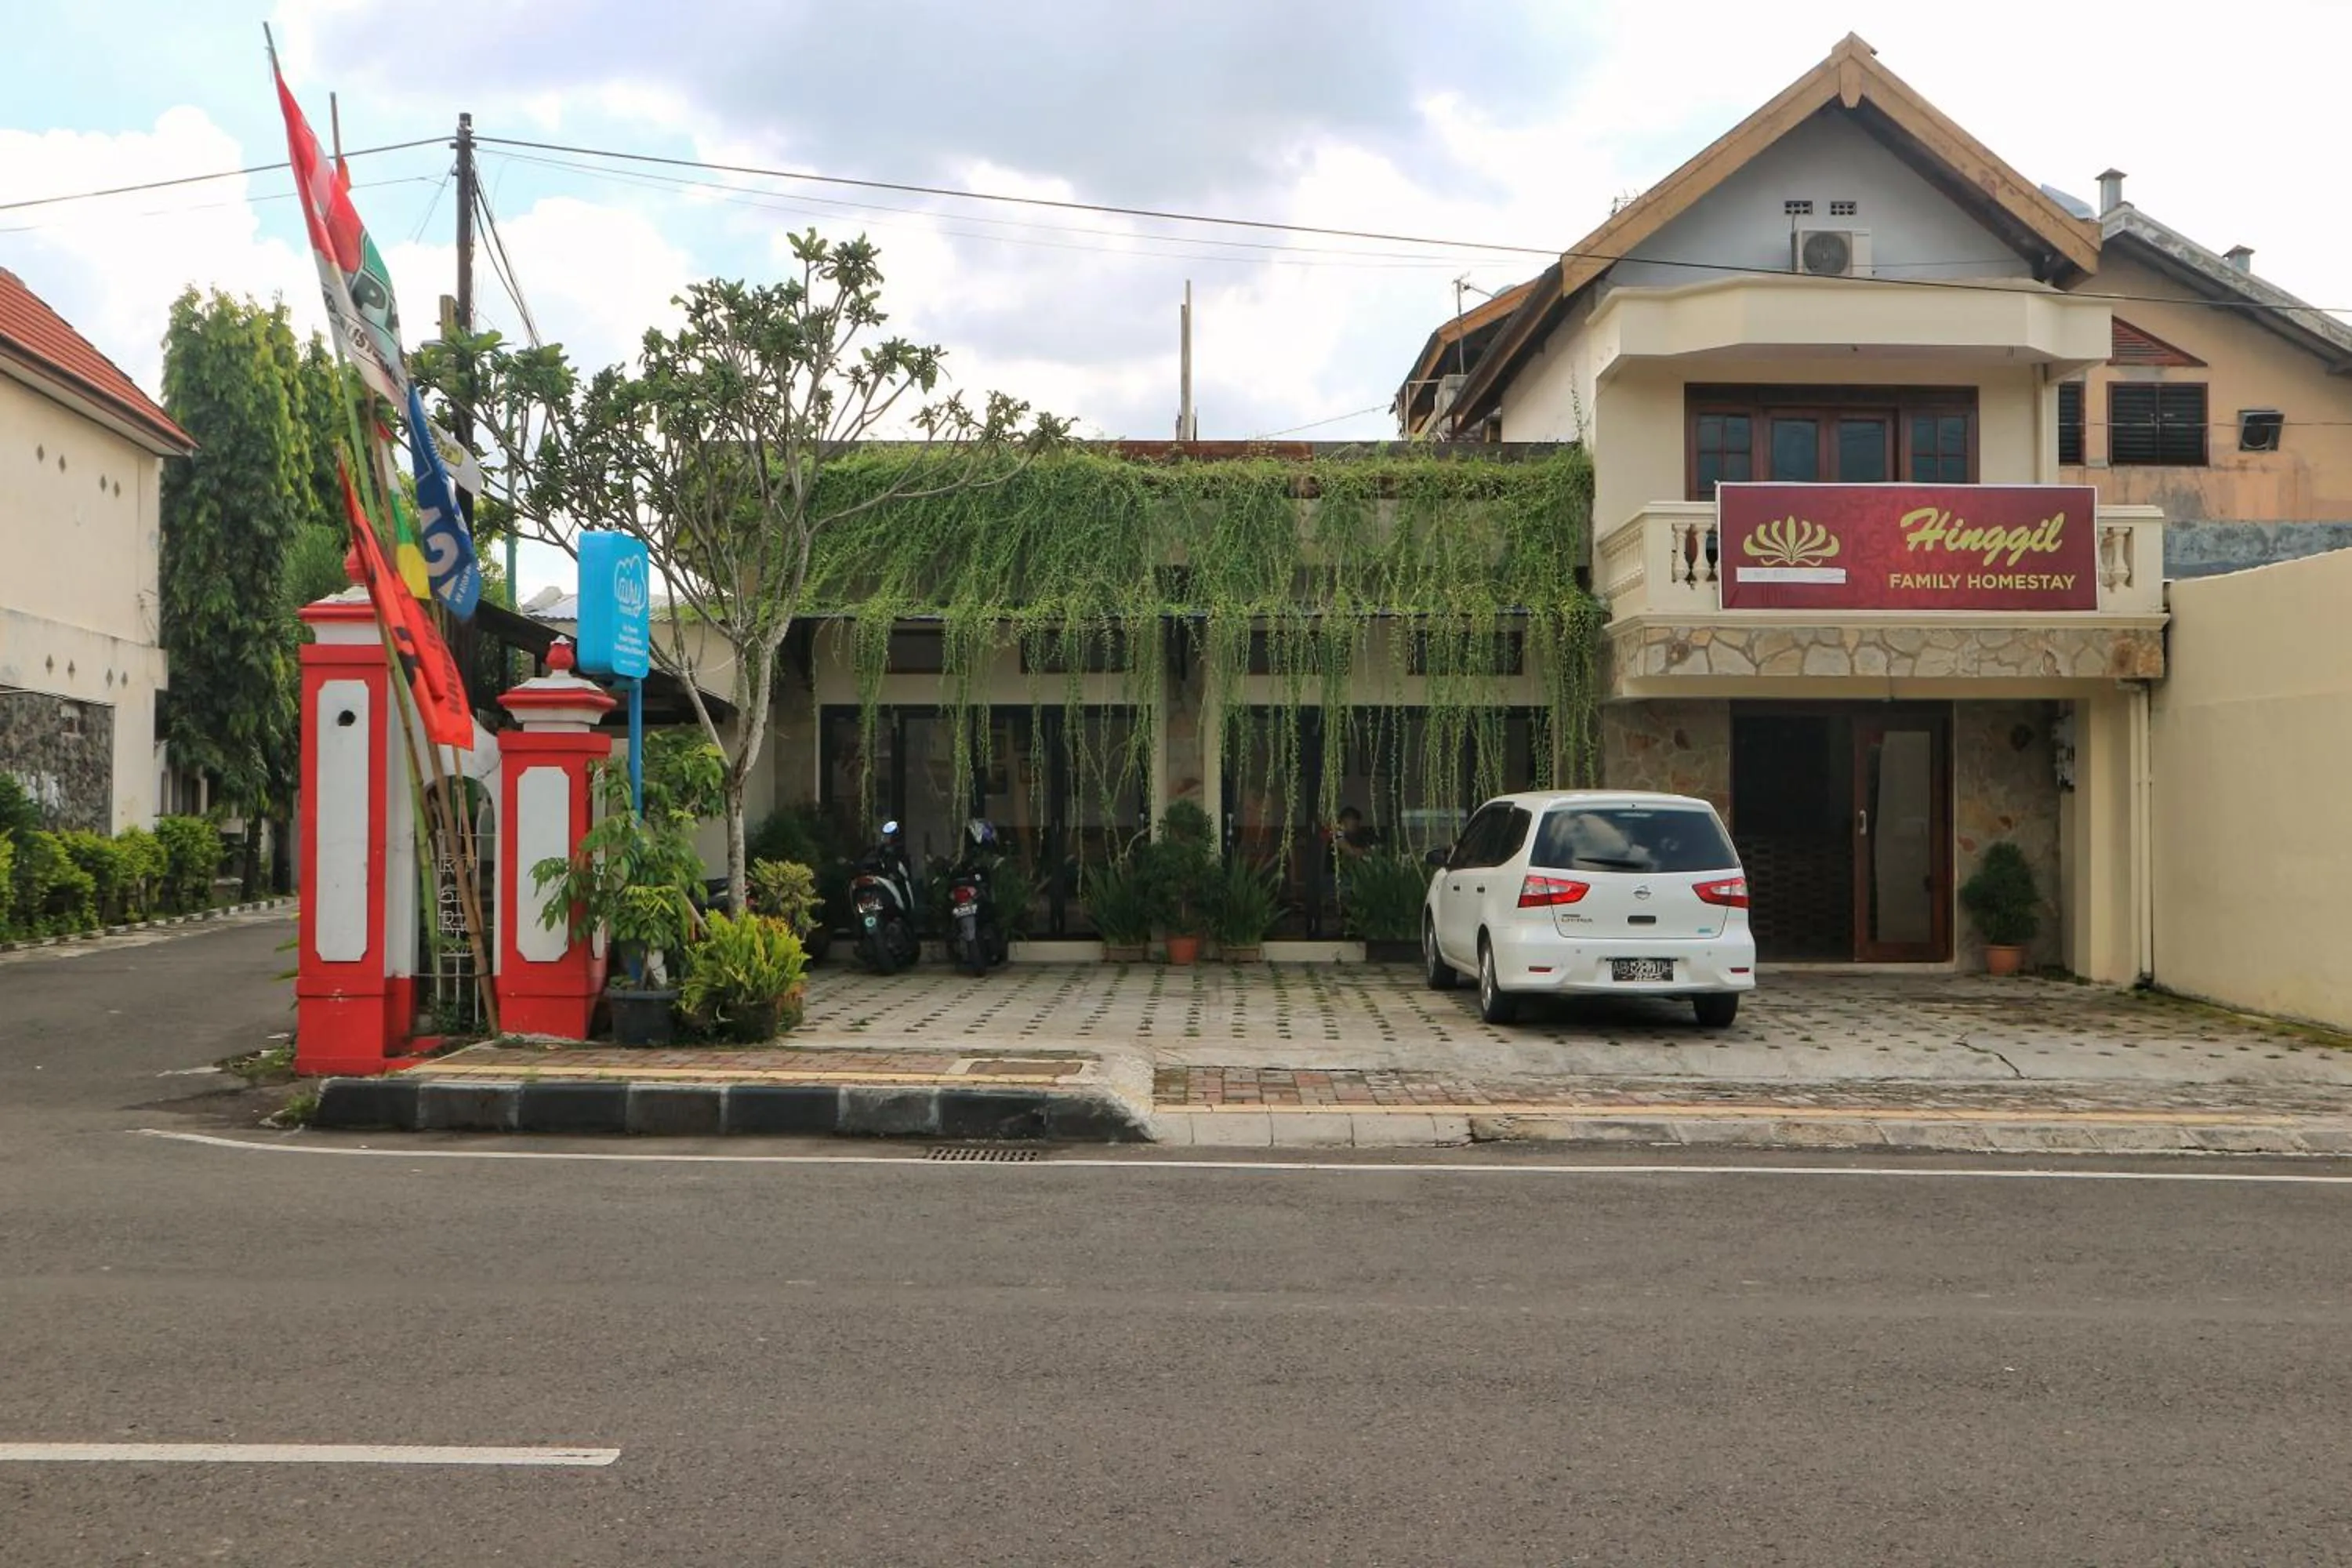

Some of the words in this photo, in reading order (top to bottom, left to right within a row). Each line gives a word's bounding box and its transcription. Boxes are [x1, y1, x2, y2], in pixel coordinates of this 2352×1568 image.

[1900, 508, 2064, 566] Hinggil
[1889, 573, 1961, 589] FAMILY
[1968, 574, 2075, 590] HOMESTAY
